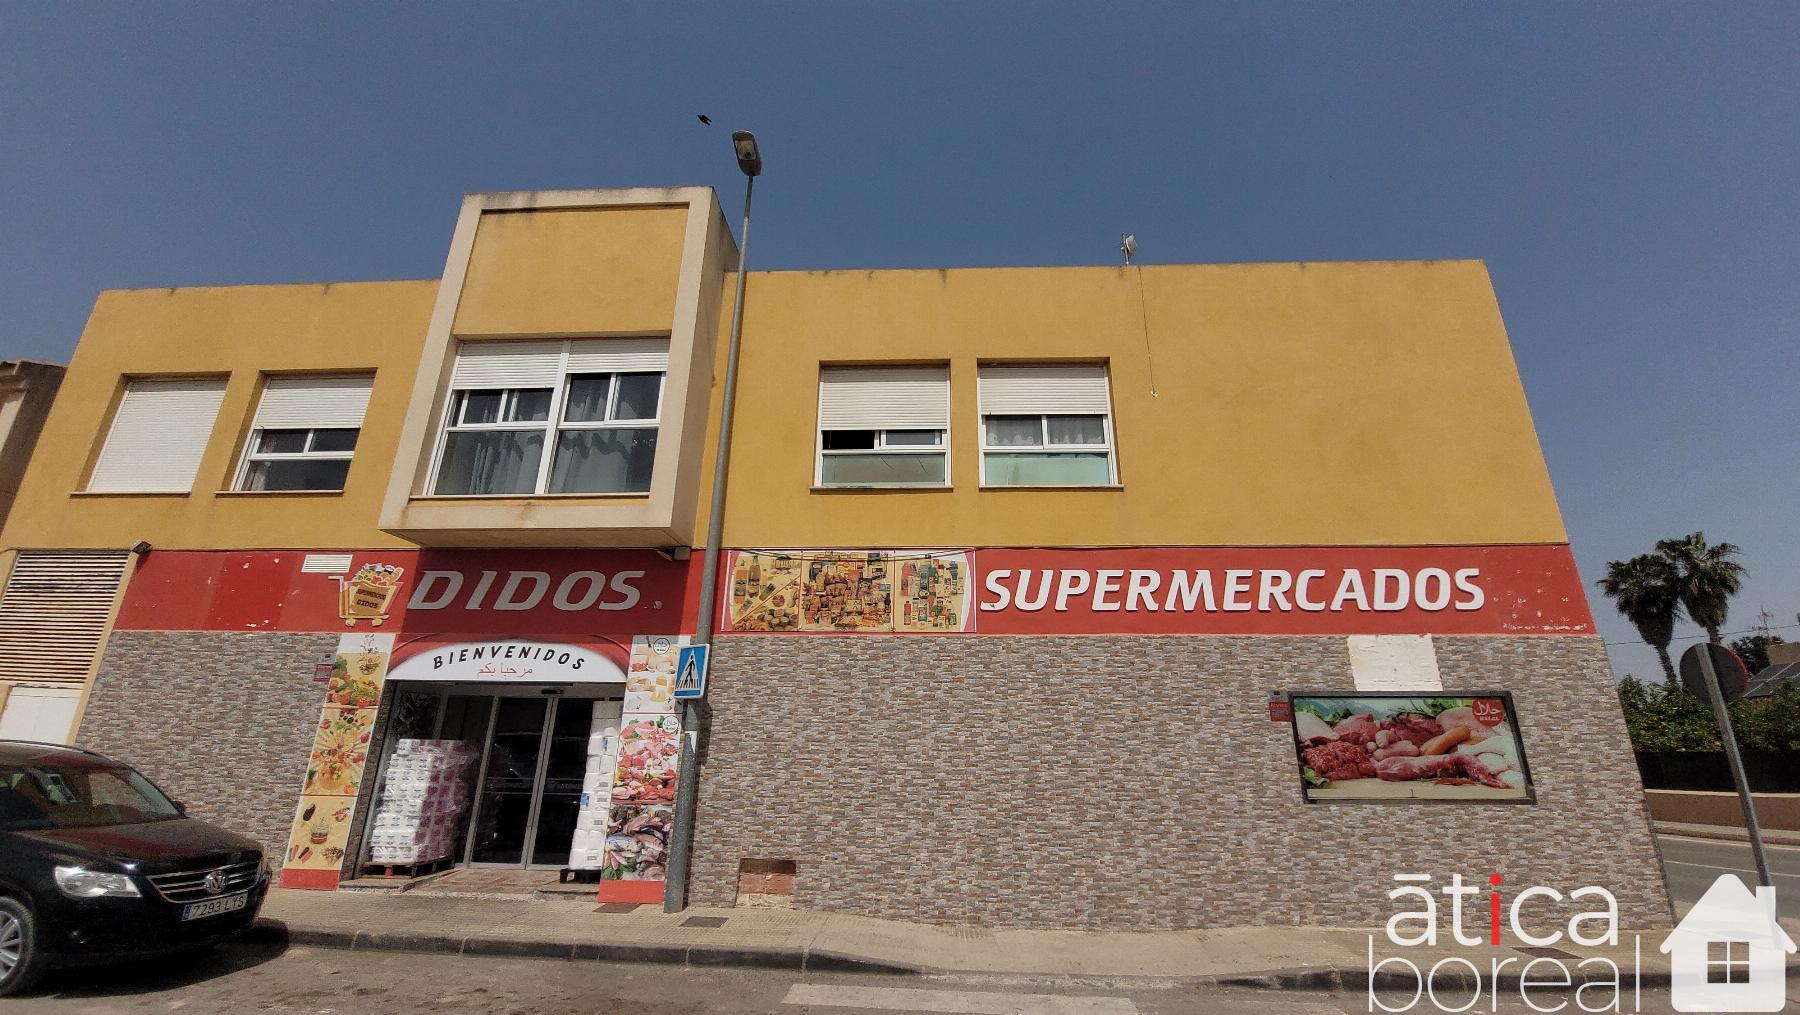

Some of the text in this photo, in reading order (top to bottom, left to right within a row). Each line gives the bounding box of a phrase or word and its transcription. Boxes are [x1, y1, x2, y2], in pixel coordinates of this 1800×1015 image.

[406, 570, 646, 611] DIDOS
[979, 568, 1486, 611] SUPERMERCADOS
[356, 599, 378, 609] DIDOS
[433, 645, 585, 670] BIENVENIDOS
[1474, 701, 1501, 716] حلال
[193, 896, 245, 917] 7293 LYS
